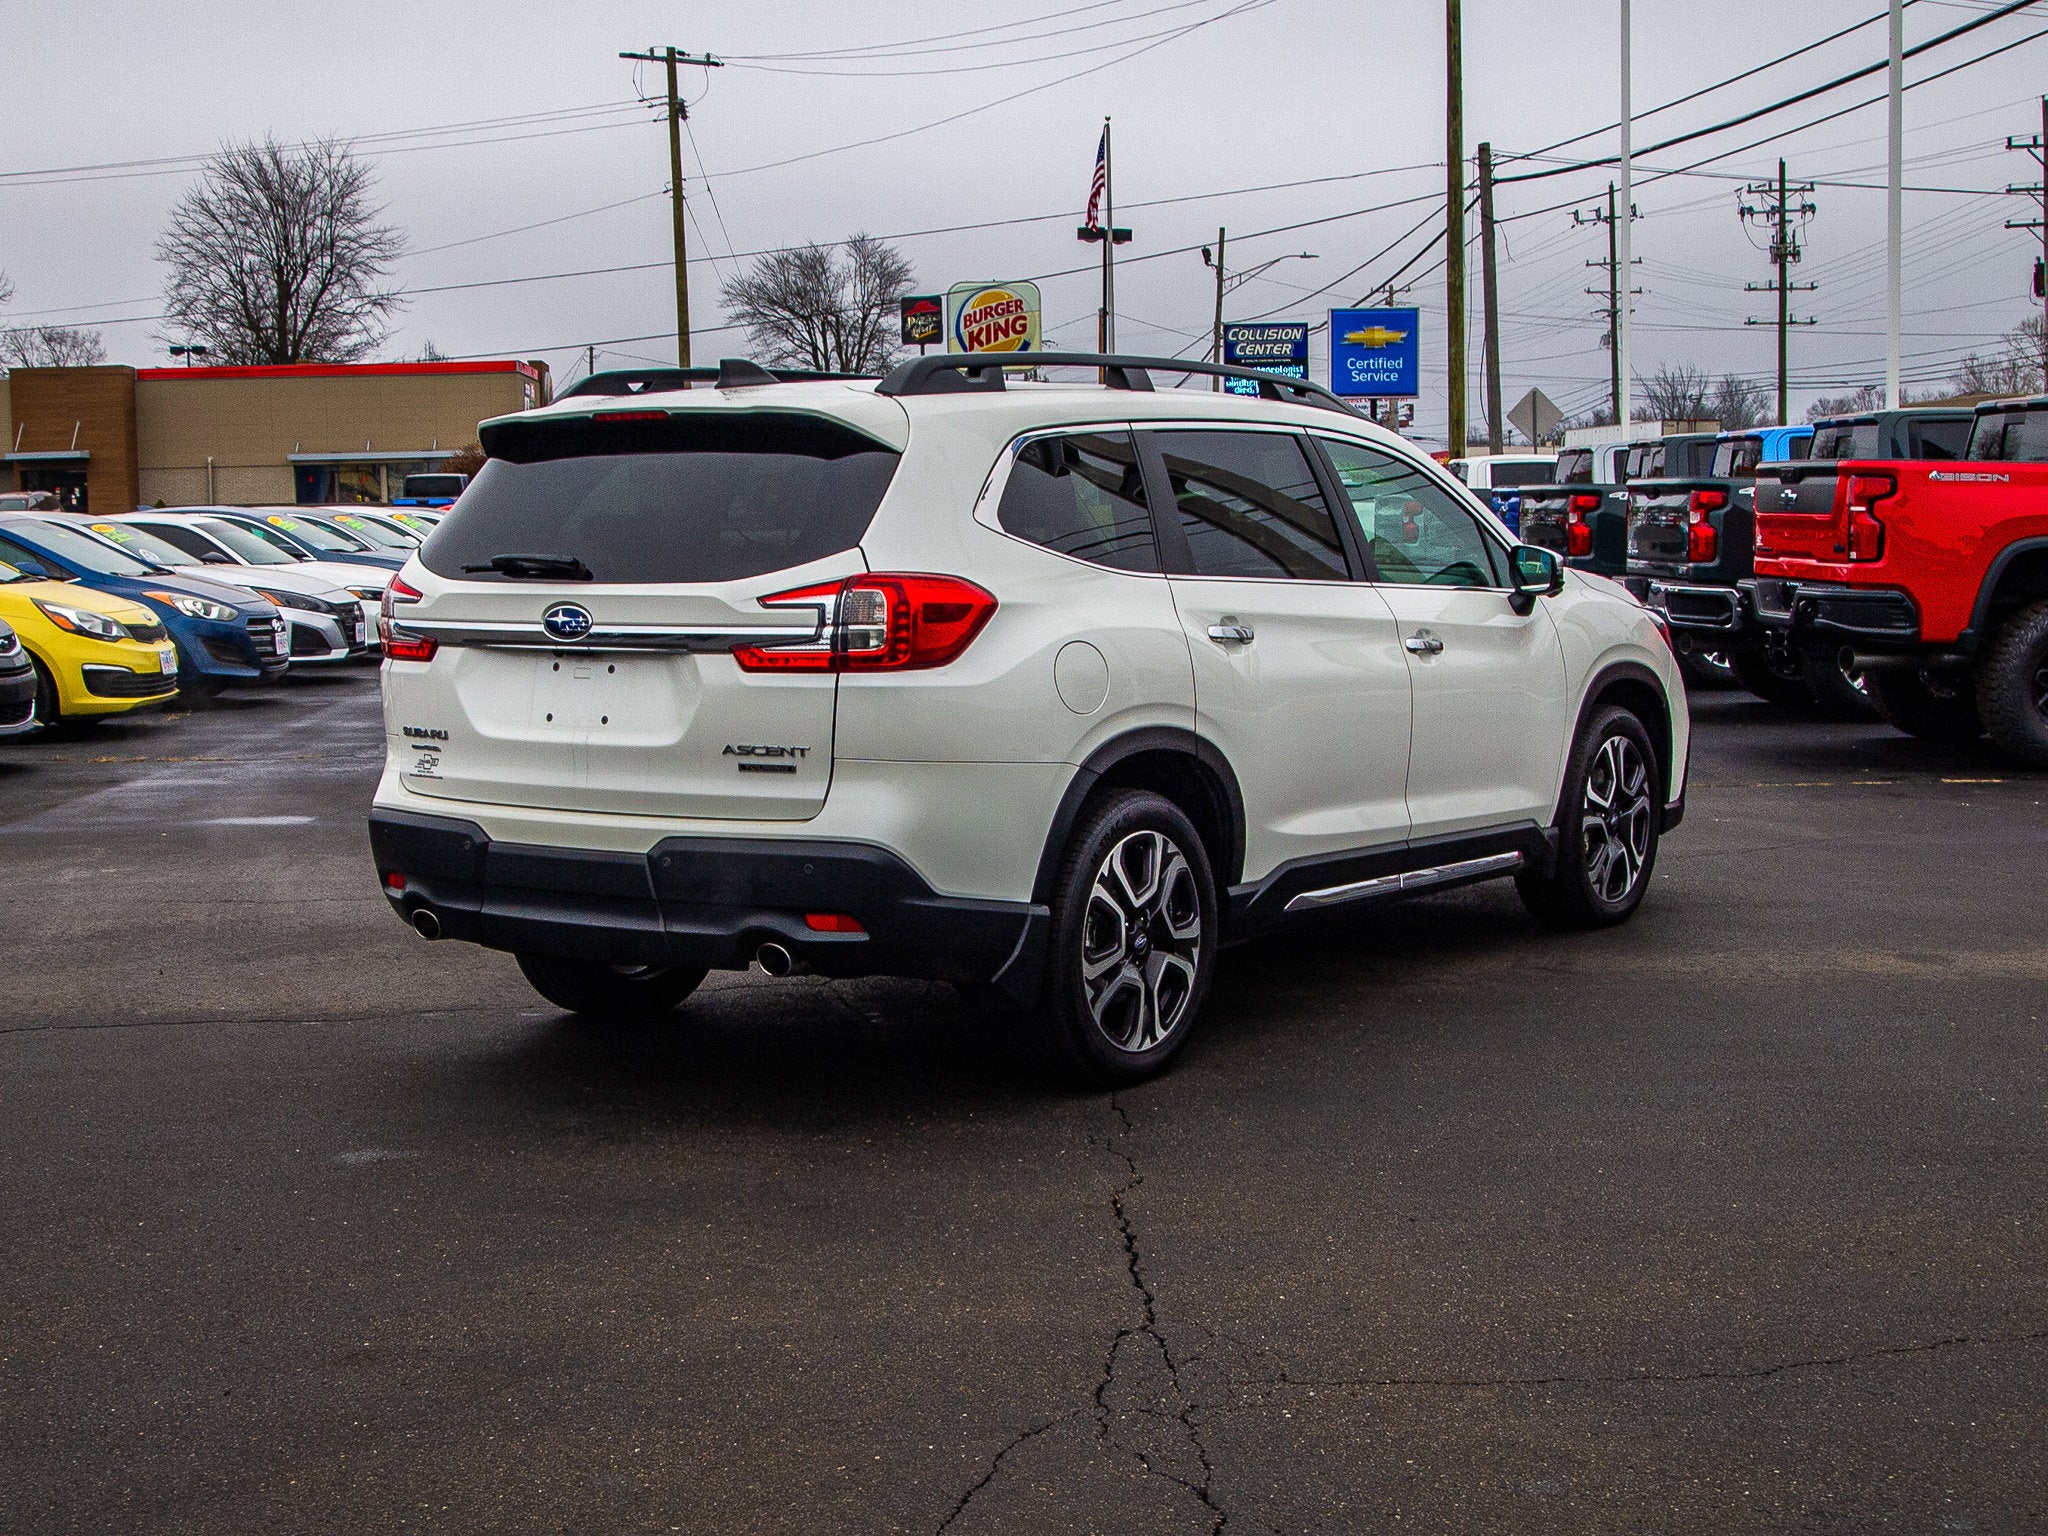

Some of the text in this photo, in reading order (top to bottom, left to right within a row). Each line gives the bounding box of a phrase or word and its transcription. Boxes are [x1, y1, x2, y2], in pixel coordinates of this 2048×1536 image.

[963, 298, 1024, 330] BURGER
[967, 314, 1028, 352] KING
[1227, 327, 1304, 342] COLLISION
[1235, 342, 1293, 356] CENTER
[1347, 357, 1403, 370] Certified
[1351, 370, 1399, 382] Service
[402, 726, 449, 740] SUBARU
[722, 744, 811, 758] ASCENT
